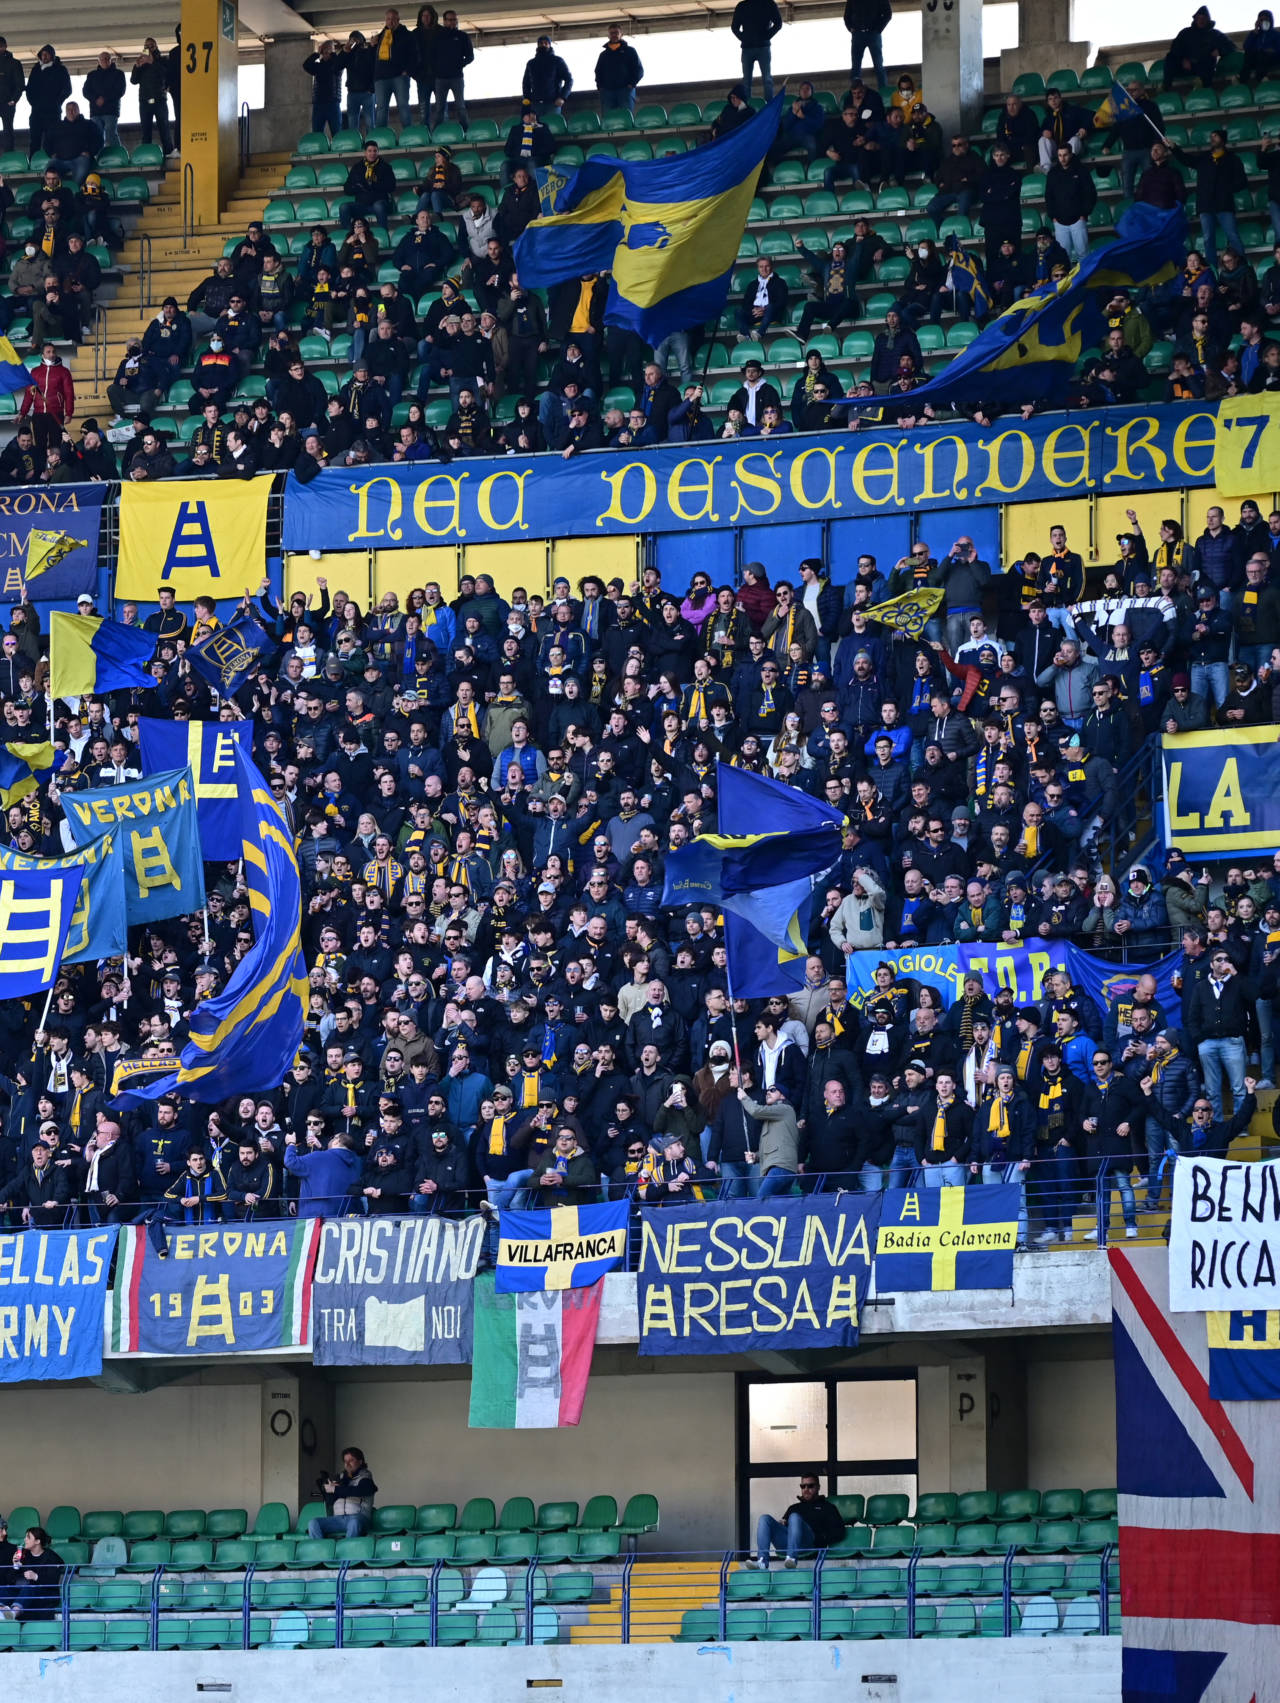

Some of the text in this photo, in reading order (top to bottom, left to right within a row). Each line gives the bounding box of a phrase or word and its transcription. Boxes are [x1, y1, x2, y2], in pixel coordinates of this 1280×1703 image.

[185, 41, 214, 74] 37
[73, 779, 192, 826] VERONA
[1169, 756, 1251, 831] LA
[122, 1060, 177, 1073] HELLAS
[315, 1218, 486, 1284] CRISTIANO
[507, 1236, 617, 1263] VILLAFRANCA
[149, 1290, 275, 1318] 19 03
[684, 1277, 821, 1336] RESA
[323, 1306, 461, 1342] TRA NOI
